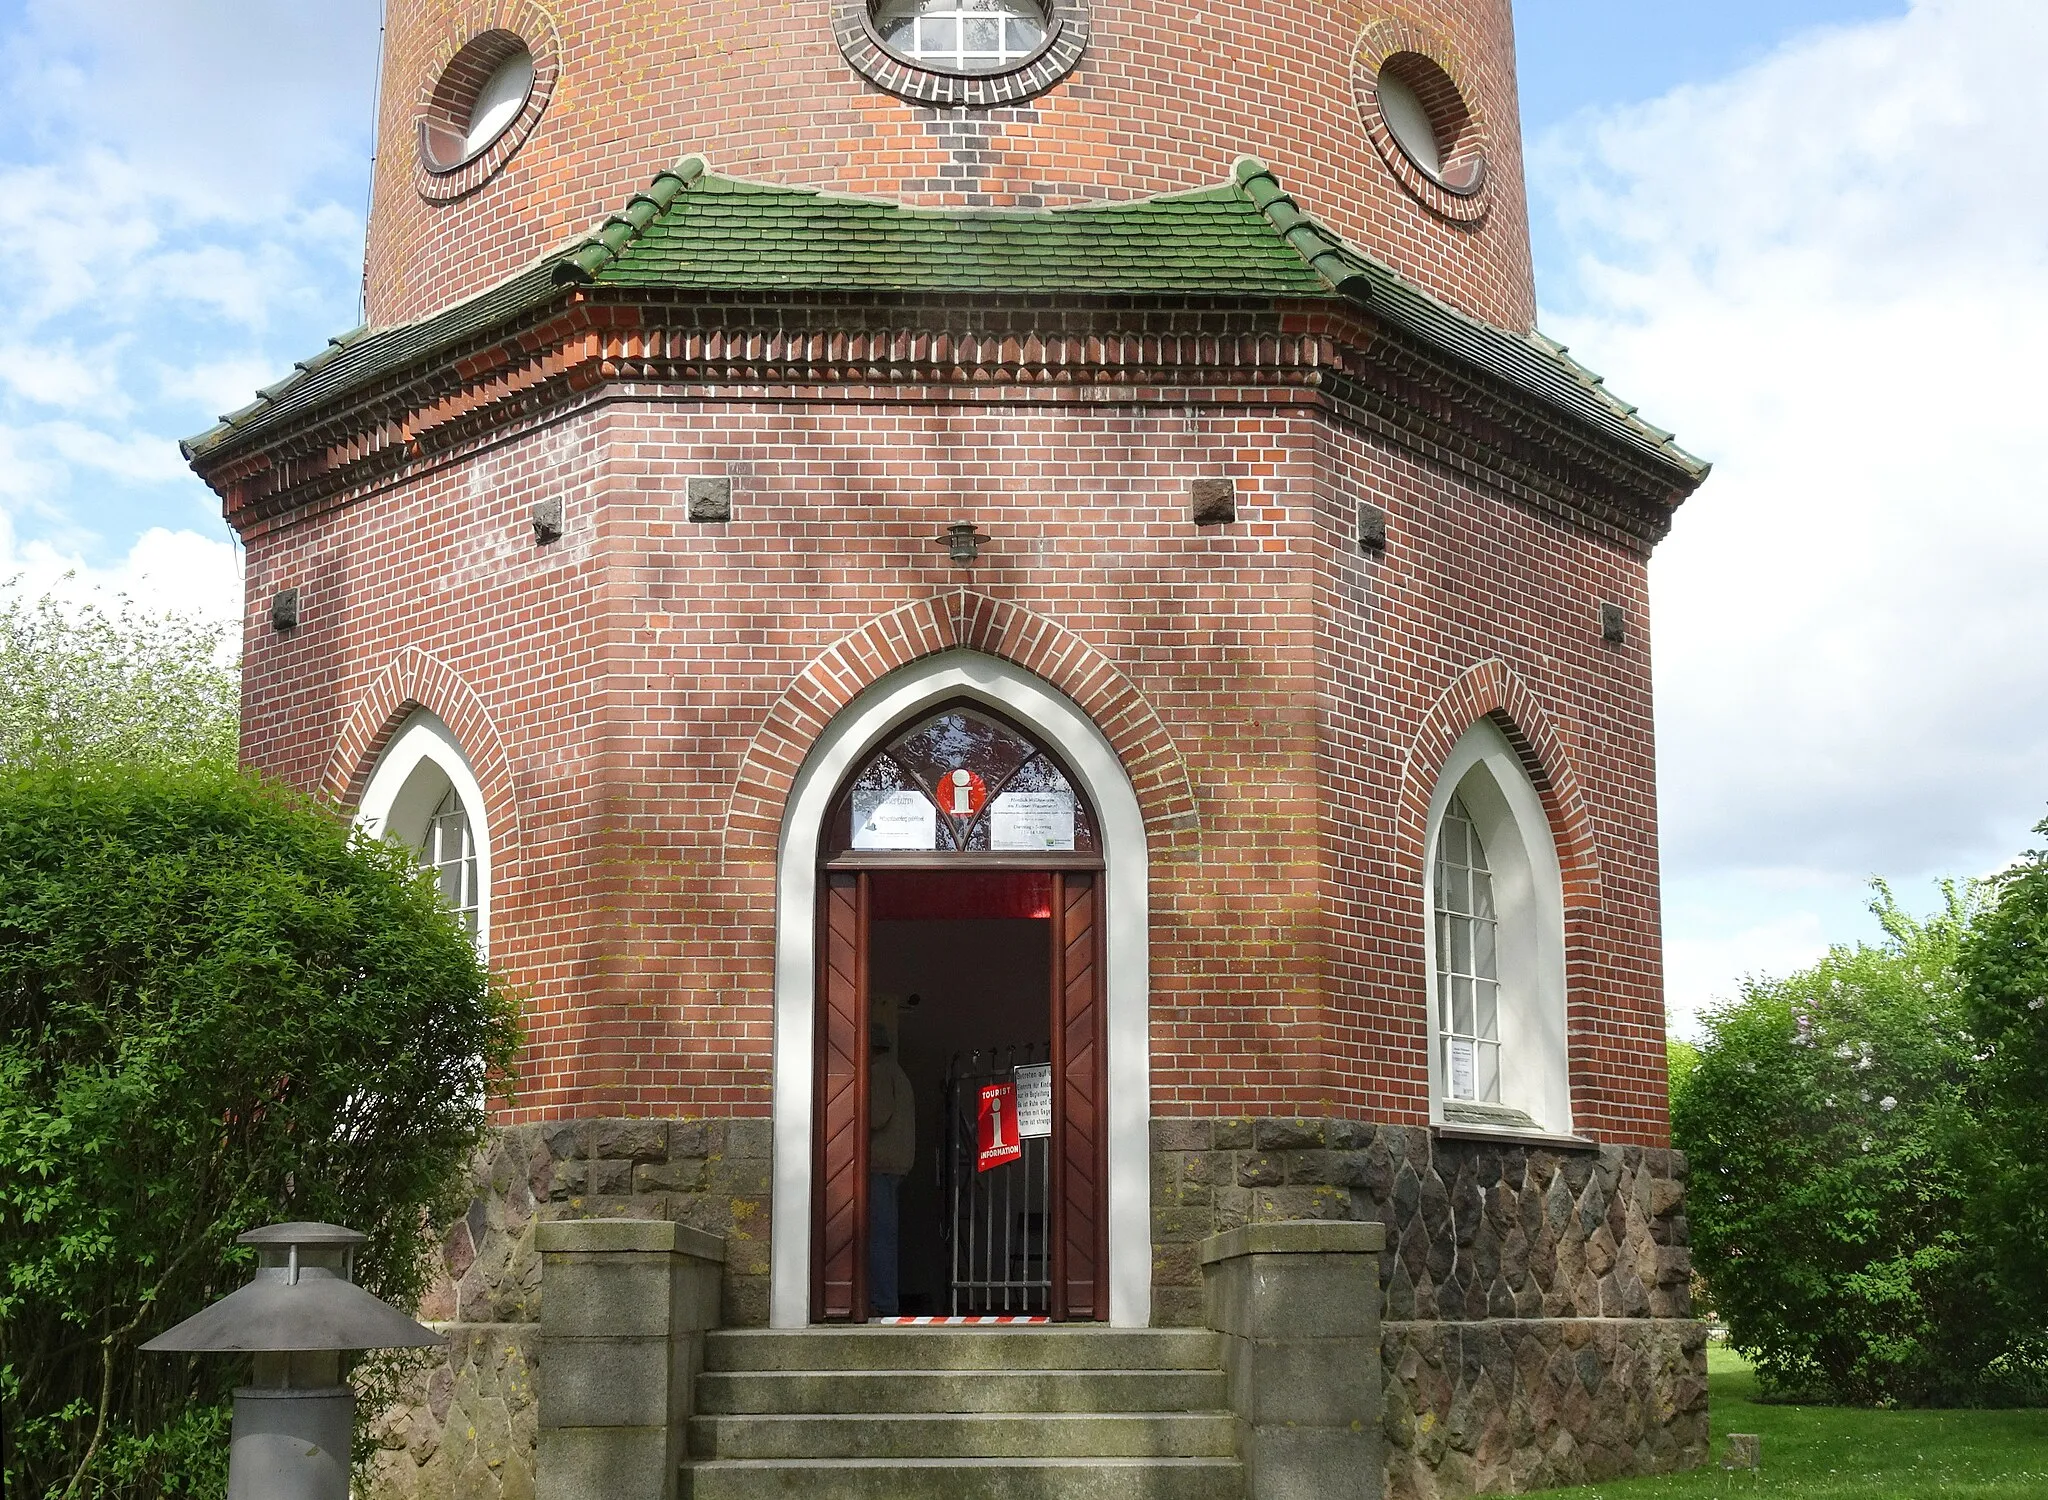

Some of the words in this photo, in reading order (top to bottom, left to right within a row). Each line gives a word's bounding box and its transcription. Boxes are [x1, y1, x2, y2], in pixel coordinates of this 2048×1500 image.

[951, 769, 973, 813] i
[982, 1086, 1011, 1100] TOURIST
[989, 1098, 1007, 1149] i
[980, 1145, 1018, 1159] INFORMATION
